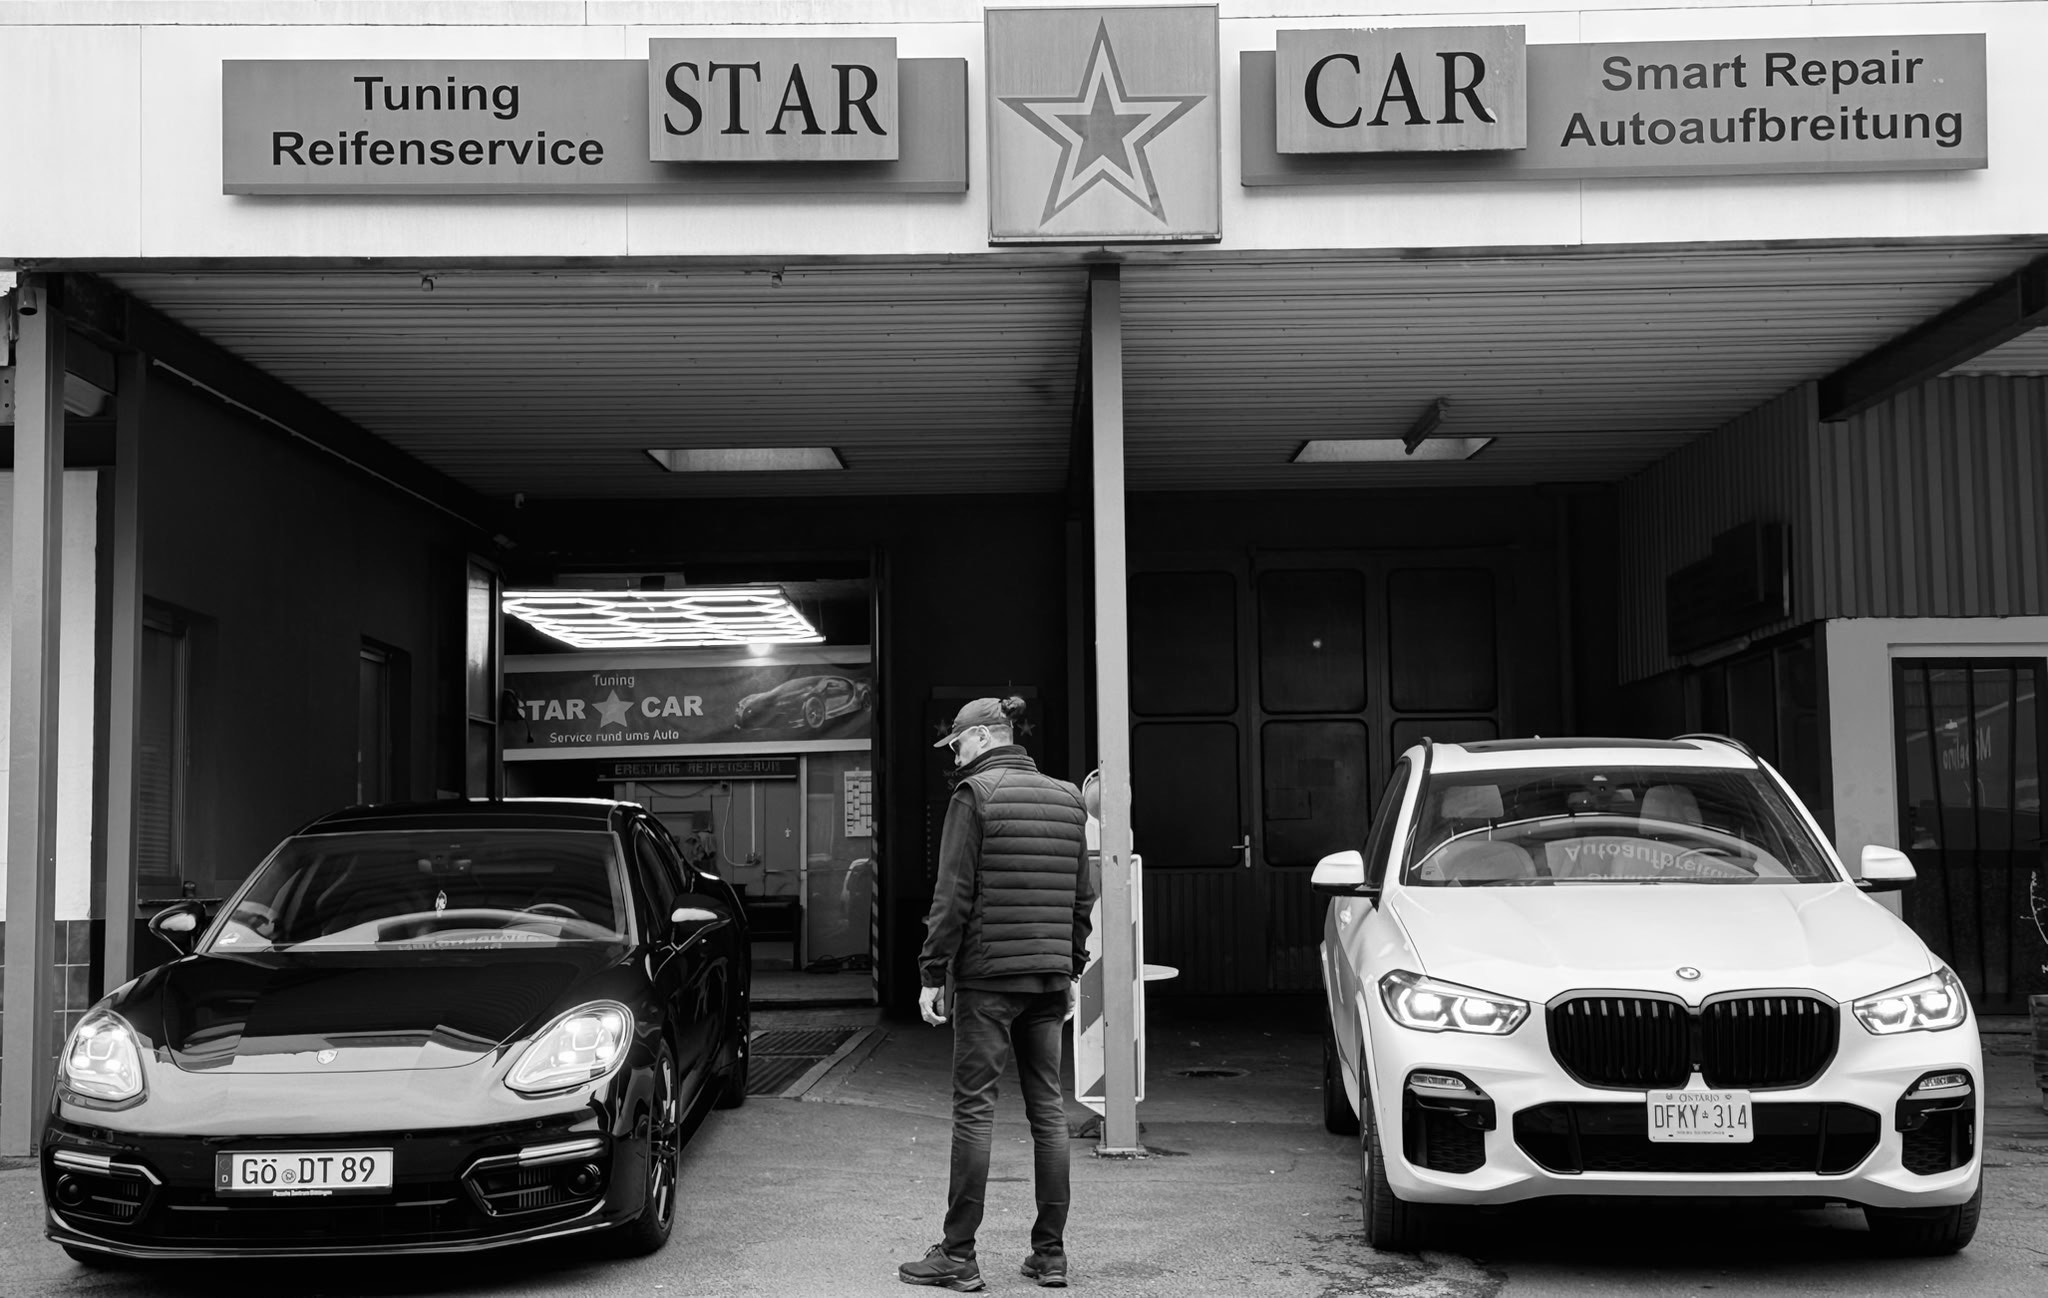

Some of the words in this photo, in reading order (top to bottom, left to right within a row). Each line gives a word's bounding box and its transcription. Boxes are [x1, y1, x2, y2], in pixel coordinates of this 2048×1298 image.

[1304, 51, 1497, 129] CAR
[1601, 54, 1748, 92] Smart
[1765, 49, 1925, 95] Repair
[353, 75, 520, 120] Tuning
[663, 61, 888, 136] STAR
[1559, 105, 1963, 147] Autoaufbreitung
[271, 130, 605, 167] Reifenservice
[592, 674, 635, 688] Tuning
[641, 695, 704, 718] CAR
[550, 731, 592, 744] Service
[595, 729, 623, 743] rund
[624, 731, 650, 742] ums
[652, 729, 680, 741] Auto
[1654, 1104, 1699, 1129] DFKY
[1713, 1104, 1747, 1129] 314
[242, 1158, 277, 1185] GÖ
[298, 1157, 334, 1184] DT
[341, 1156, 375, 1183] 89
